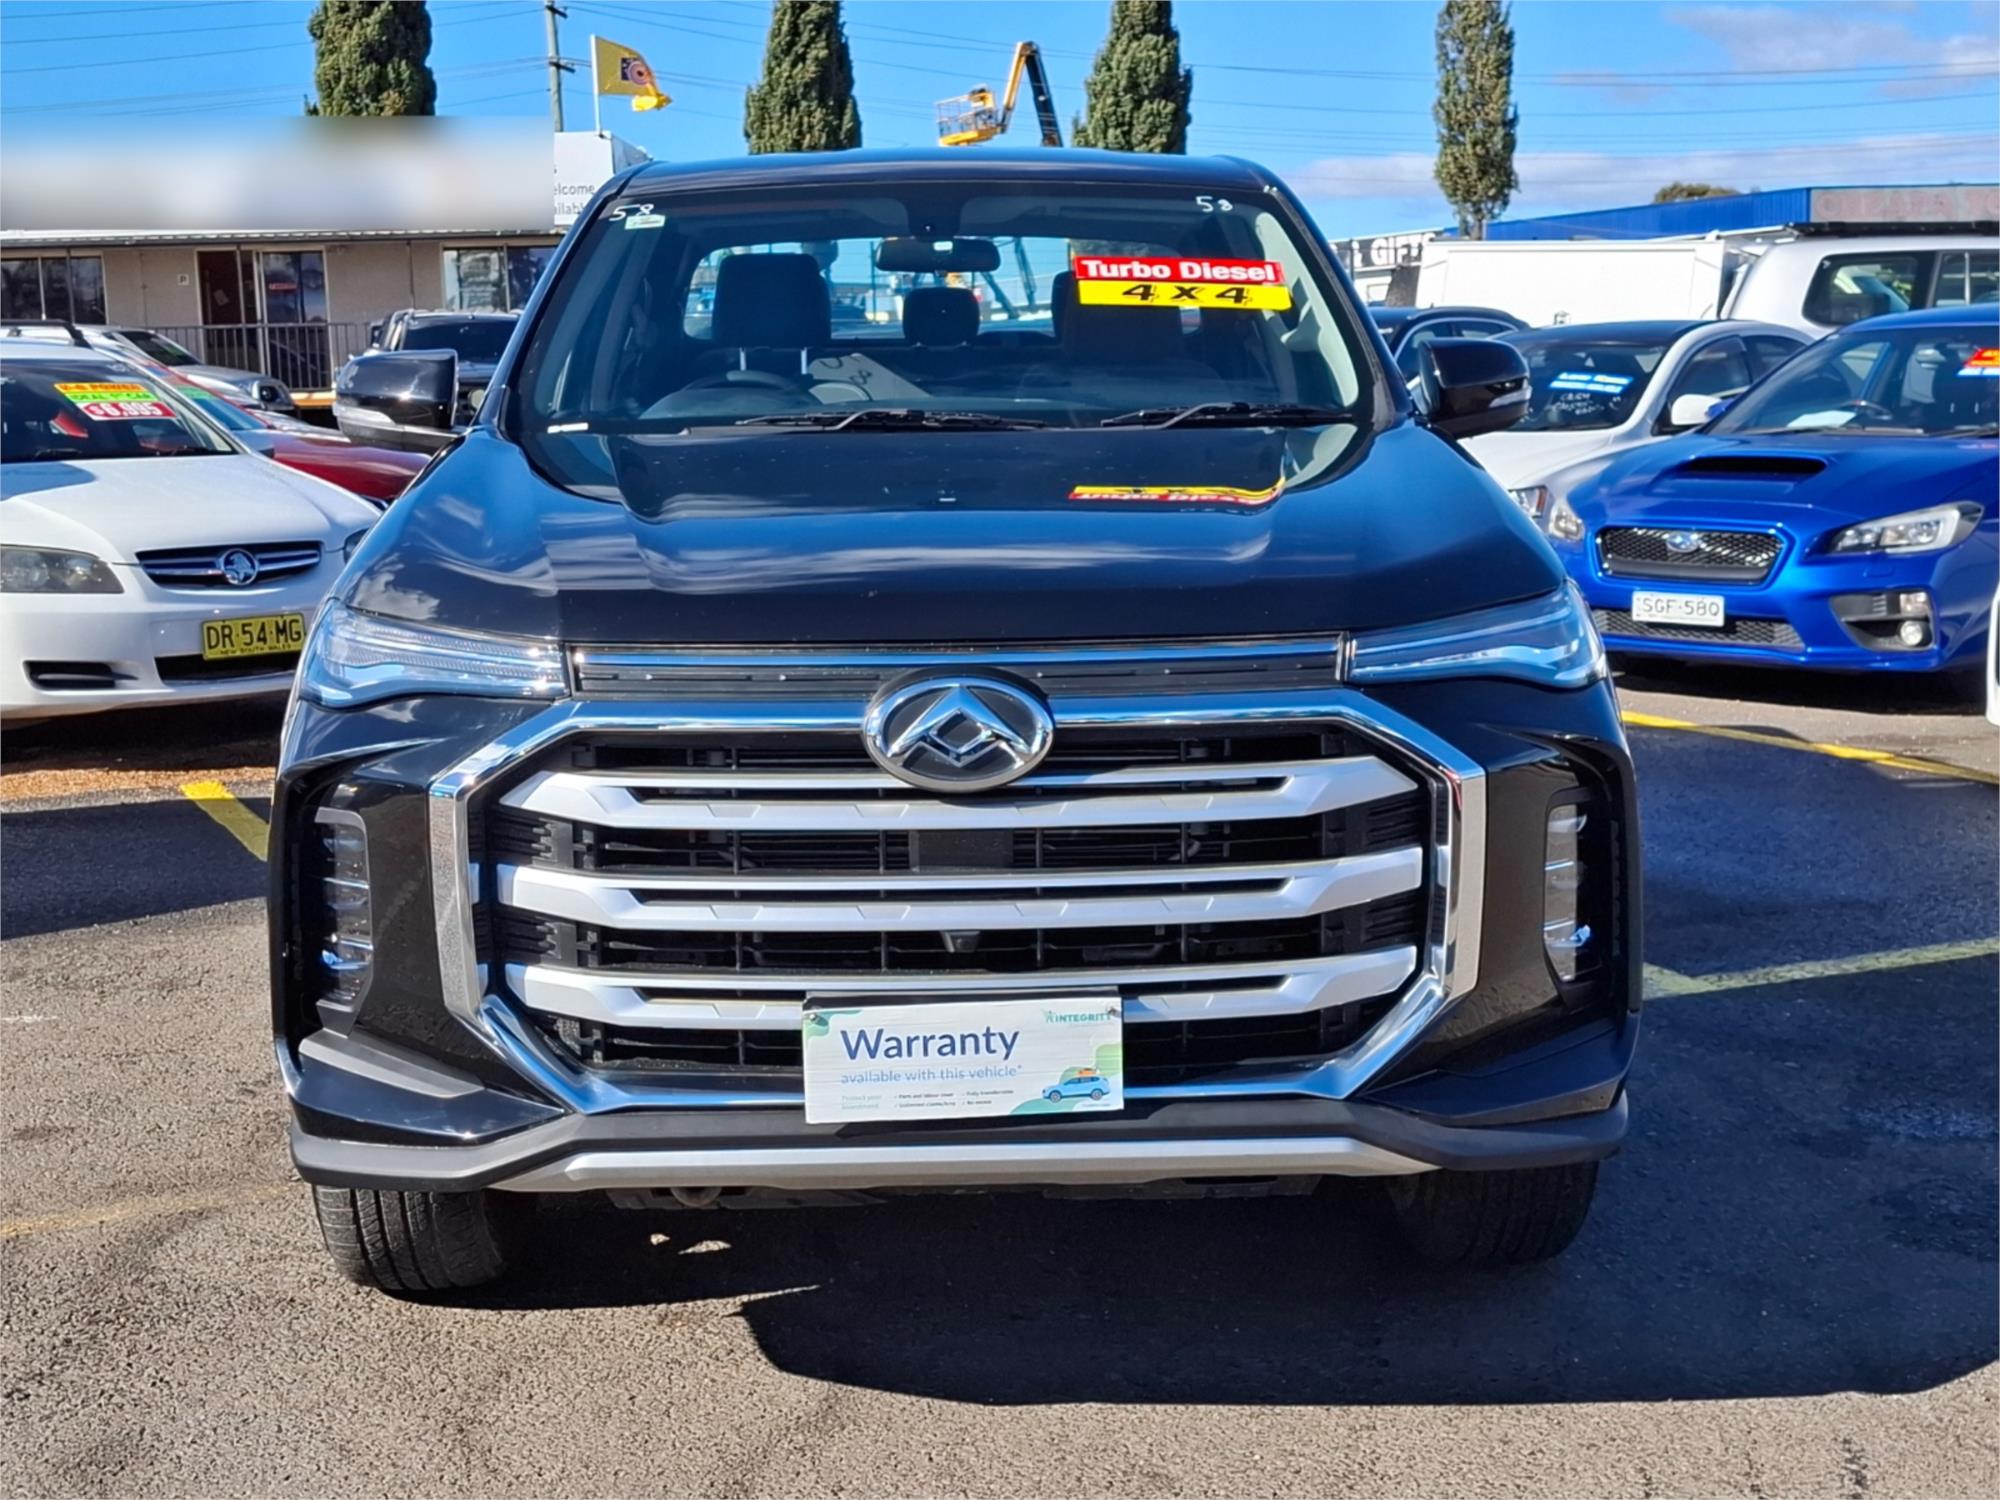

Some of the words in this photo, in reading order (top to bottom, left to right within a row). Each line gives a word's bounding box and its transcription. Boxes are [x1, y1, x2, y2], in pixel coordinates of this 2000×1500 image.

[1081, 259, 1172, 279] Turbo
[1178, 260, 1276, 280] Diesel
[1122, 284, 1156, 302] 4
[1215, 287, 1251, 304] 4
[839, 1026, 1020, 1061] Warranty
[840, 1065, 901, 1084] available
[904, 1063, 936, 1081] with
[940, 1063, 966, 1080] this
